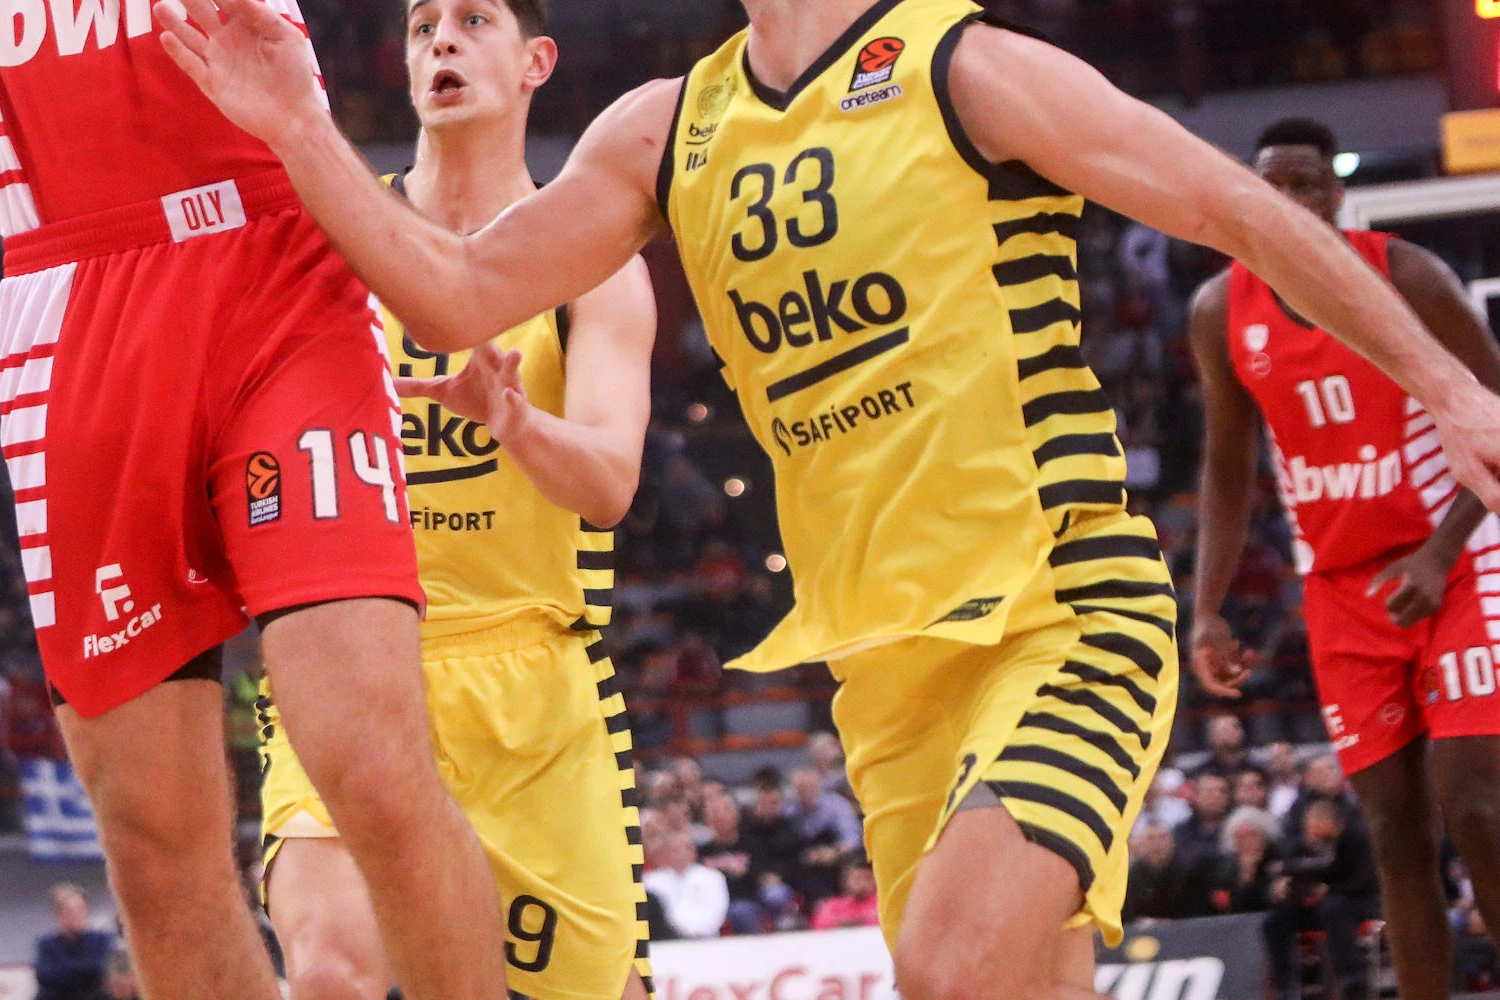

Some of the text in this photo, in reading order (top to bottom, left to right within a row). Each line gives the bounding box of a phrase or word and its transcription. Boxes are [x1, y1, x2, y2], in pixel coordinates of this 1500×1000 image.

[841, 85, 901, 110] oneteam
[181, 190, 225, 231] OLY
[731, 146, 839, 262] 33
[727, 269, 907, 354] beko
[1296, 374, 1356, 428] 10
[401, 403, 501, 458] eko
[297, 428, 401, 524] 14
[1291, 444, 1402, 503] bwin
[83, 602, 163, 659] FlexCar
[1438, 645, 1496, 701] 10
[504, 894, 558, 973] 9
[656, 966, 882, 1000] lexCar
